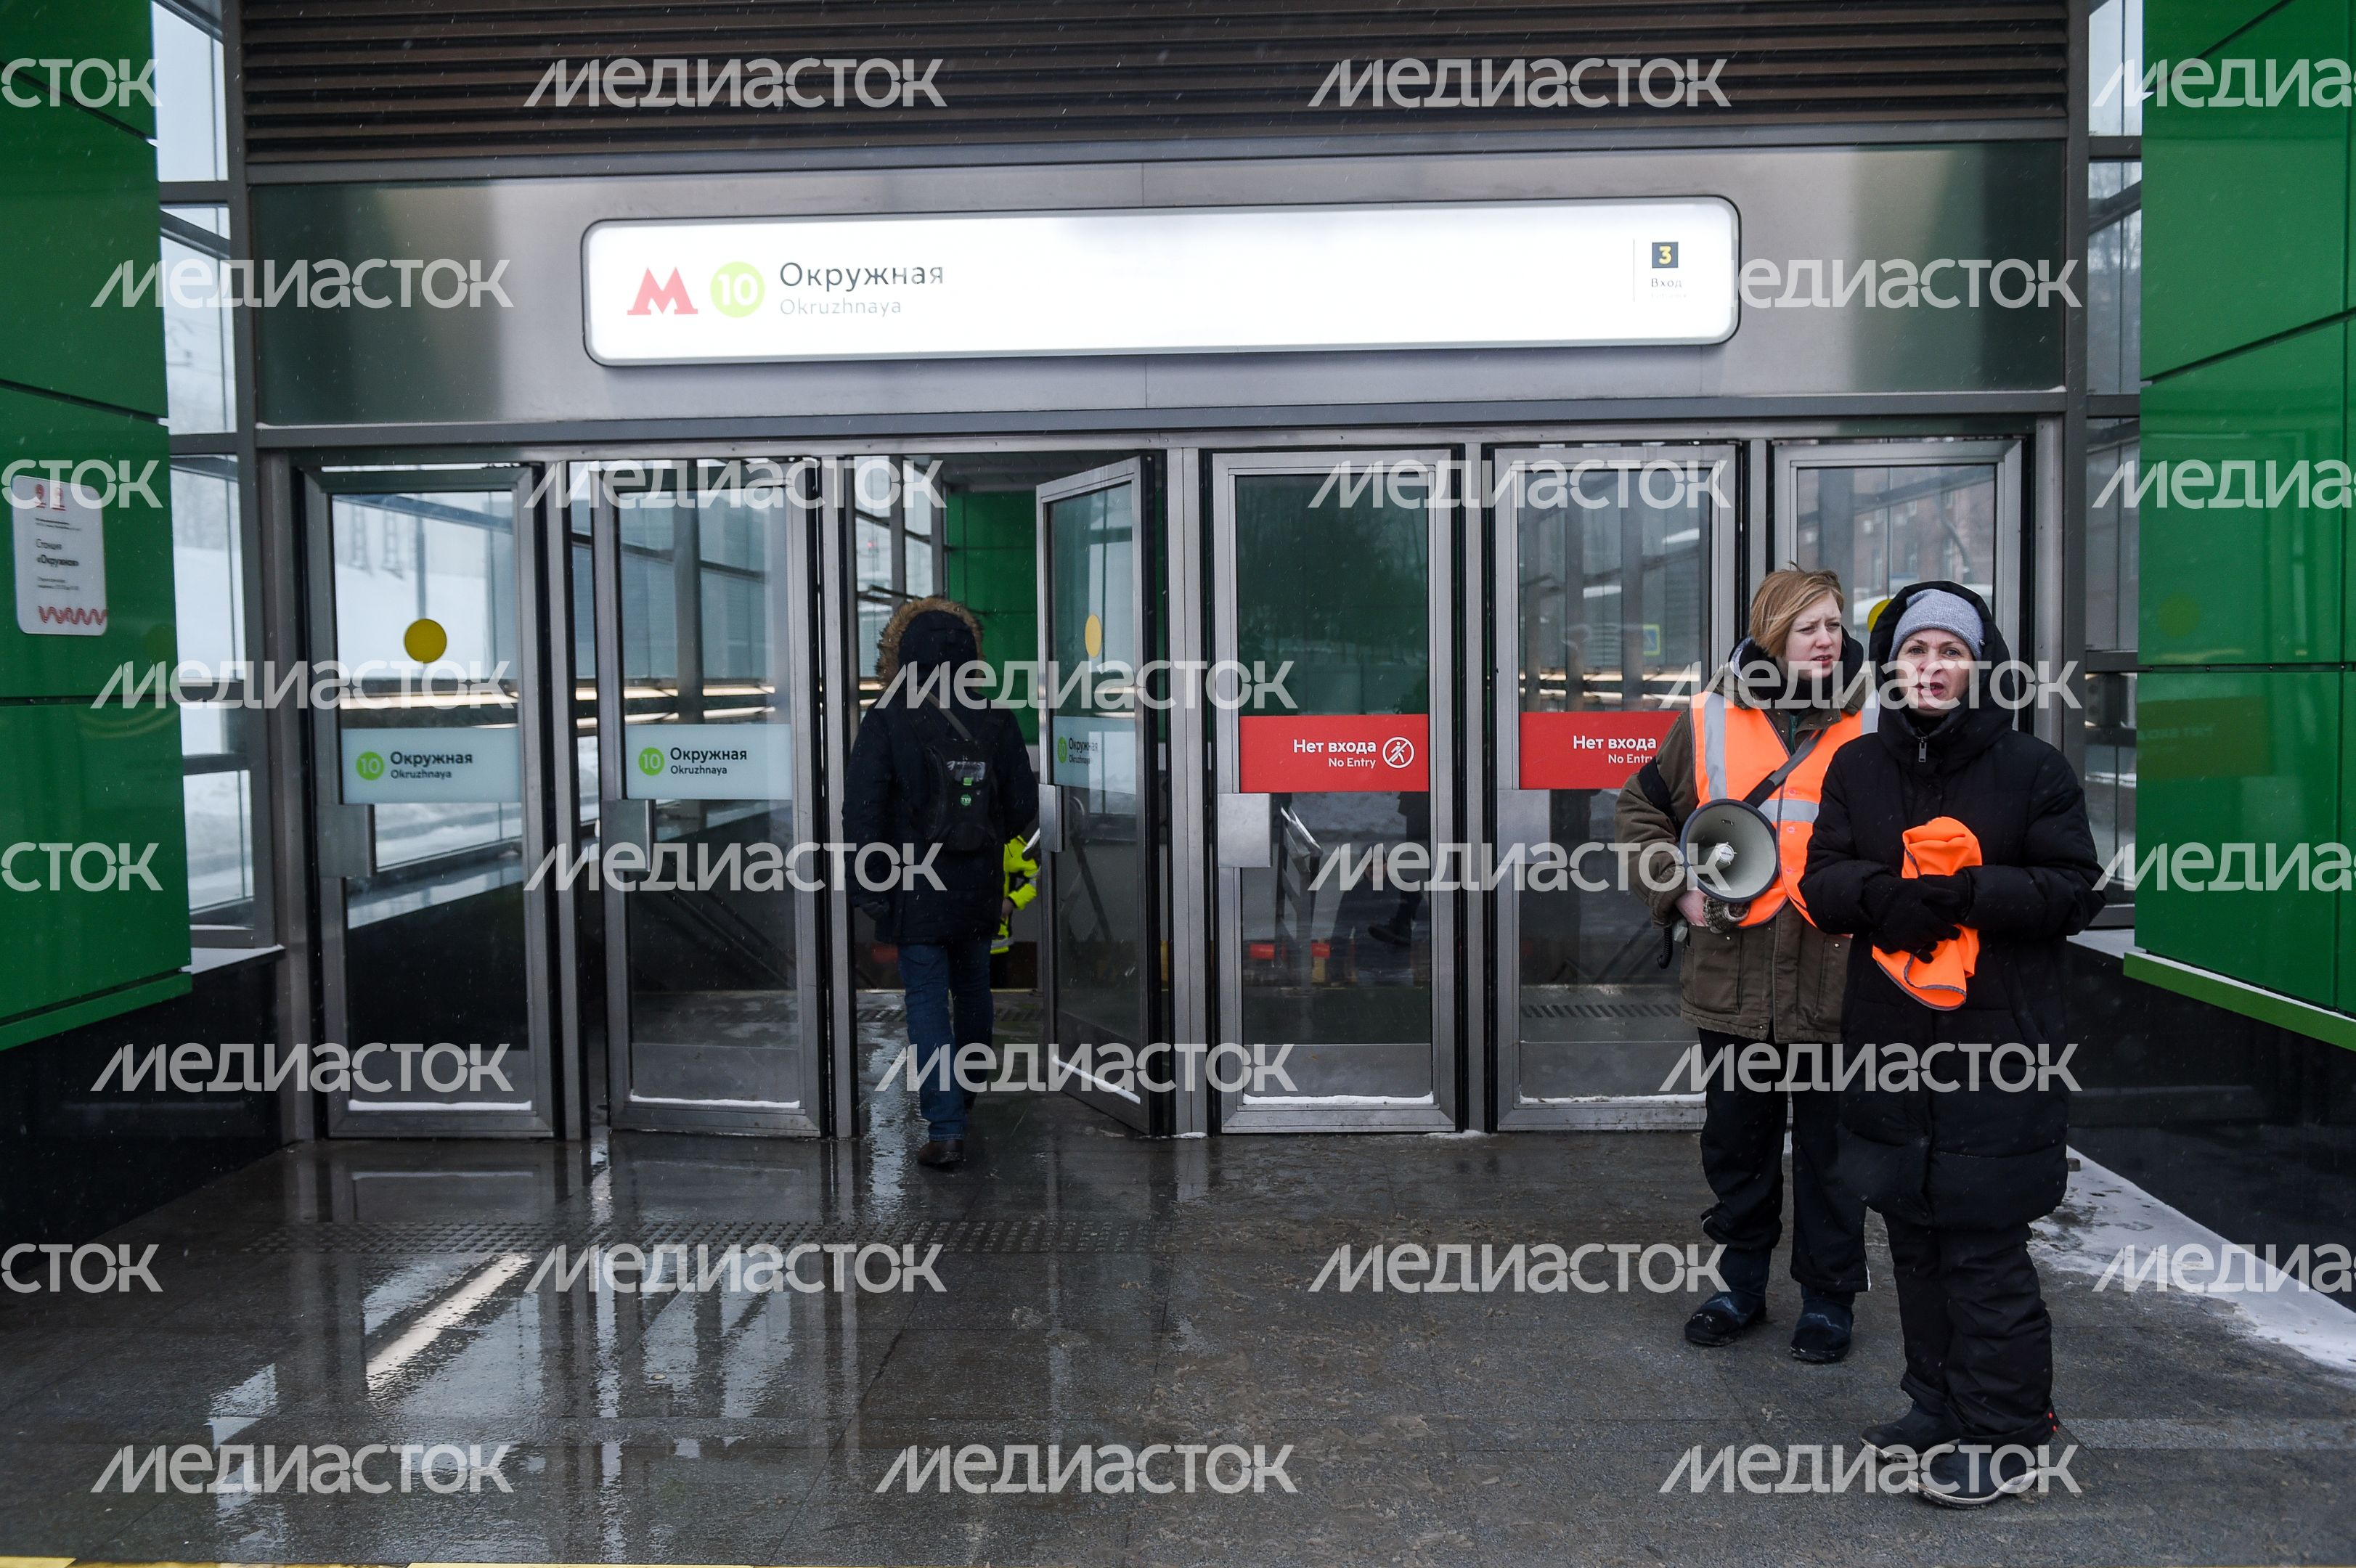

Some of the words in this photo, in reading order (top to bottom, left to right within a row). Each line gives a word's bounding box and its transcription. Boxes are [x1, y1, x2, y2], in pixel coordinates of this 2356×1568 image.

[1658, 245, 1673, 265] 3
[779, 262, 944, 293] Окружная
[1650, 277, 1683, 289] Вход
[717, 272, 759, 306] 10
[779, 298, 902, 317] Okruzhnaya
[1293, 739, 1324, 753] Нет
[1328, 741, 1377, 754] входа
[1573, 735, 1604, 749] Нет
[1608, 738, 1656, 751] входа
[390, 751, 473, 767] Окружная
[642, 753, 659, 770] 10
[669, 747, 747, 763] Окружная
[1328, 758, 1344, 767] No
[1347, 757, 1376, 769] Entry
[1608, 754, 1624, 764] No
[360, 757, 380, 775] 10
[670, 765, 727, 776] Okruzhnaya
[390, 769, 452, 780] Okruzhnaya
